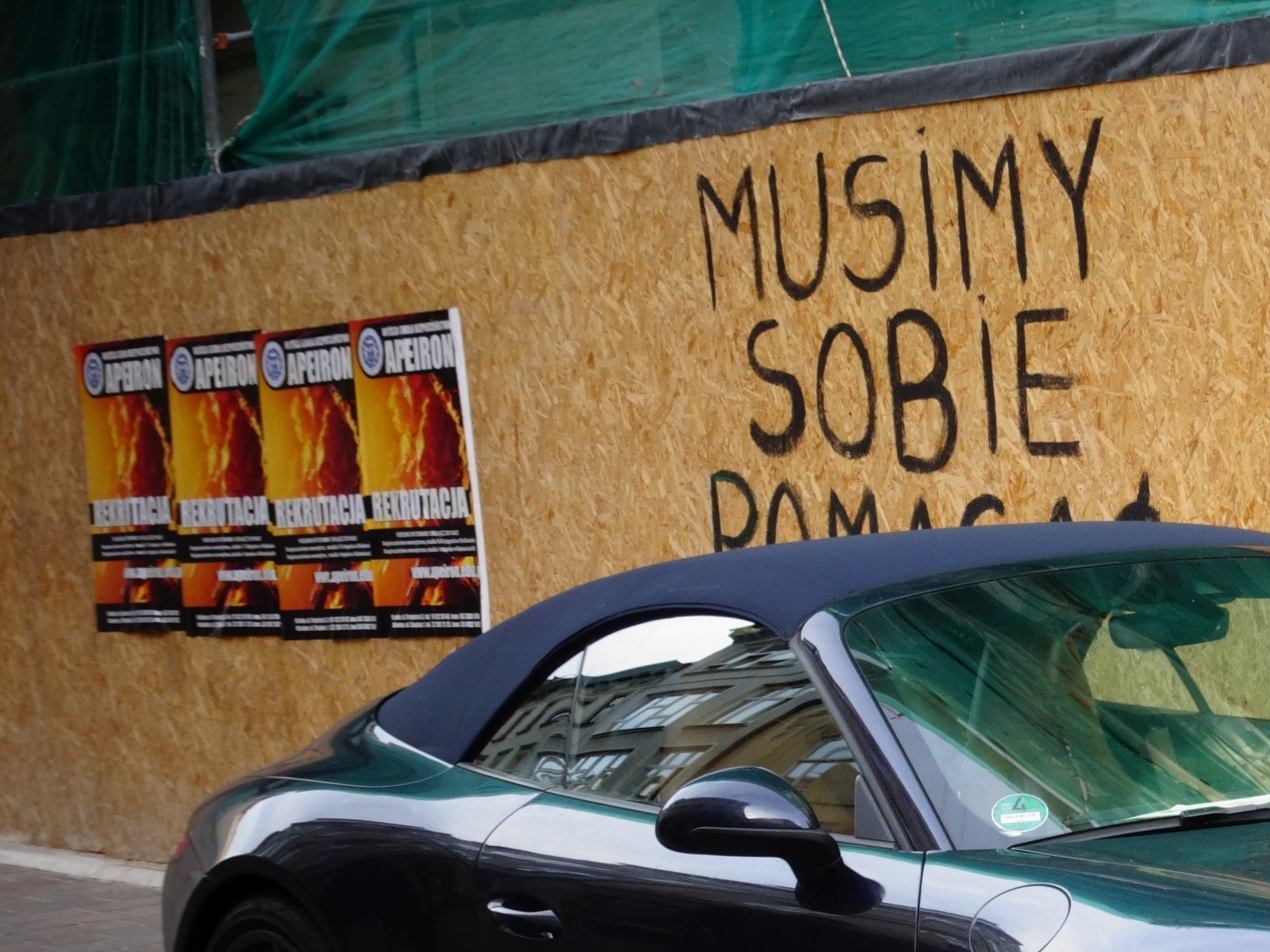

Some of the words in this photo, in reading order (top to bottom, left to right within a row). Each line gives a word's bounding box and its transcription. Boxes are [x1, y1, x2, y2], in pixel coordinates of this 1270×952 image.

[384, 333, 456, 375] APEIRON
[274, 494, 367, 529] REKRUTACJA
[371, 487, 470, 522] REKRUTACJA
[1012, 796, 1027, 812] 4
